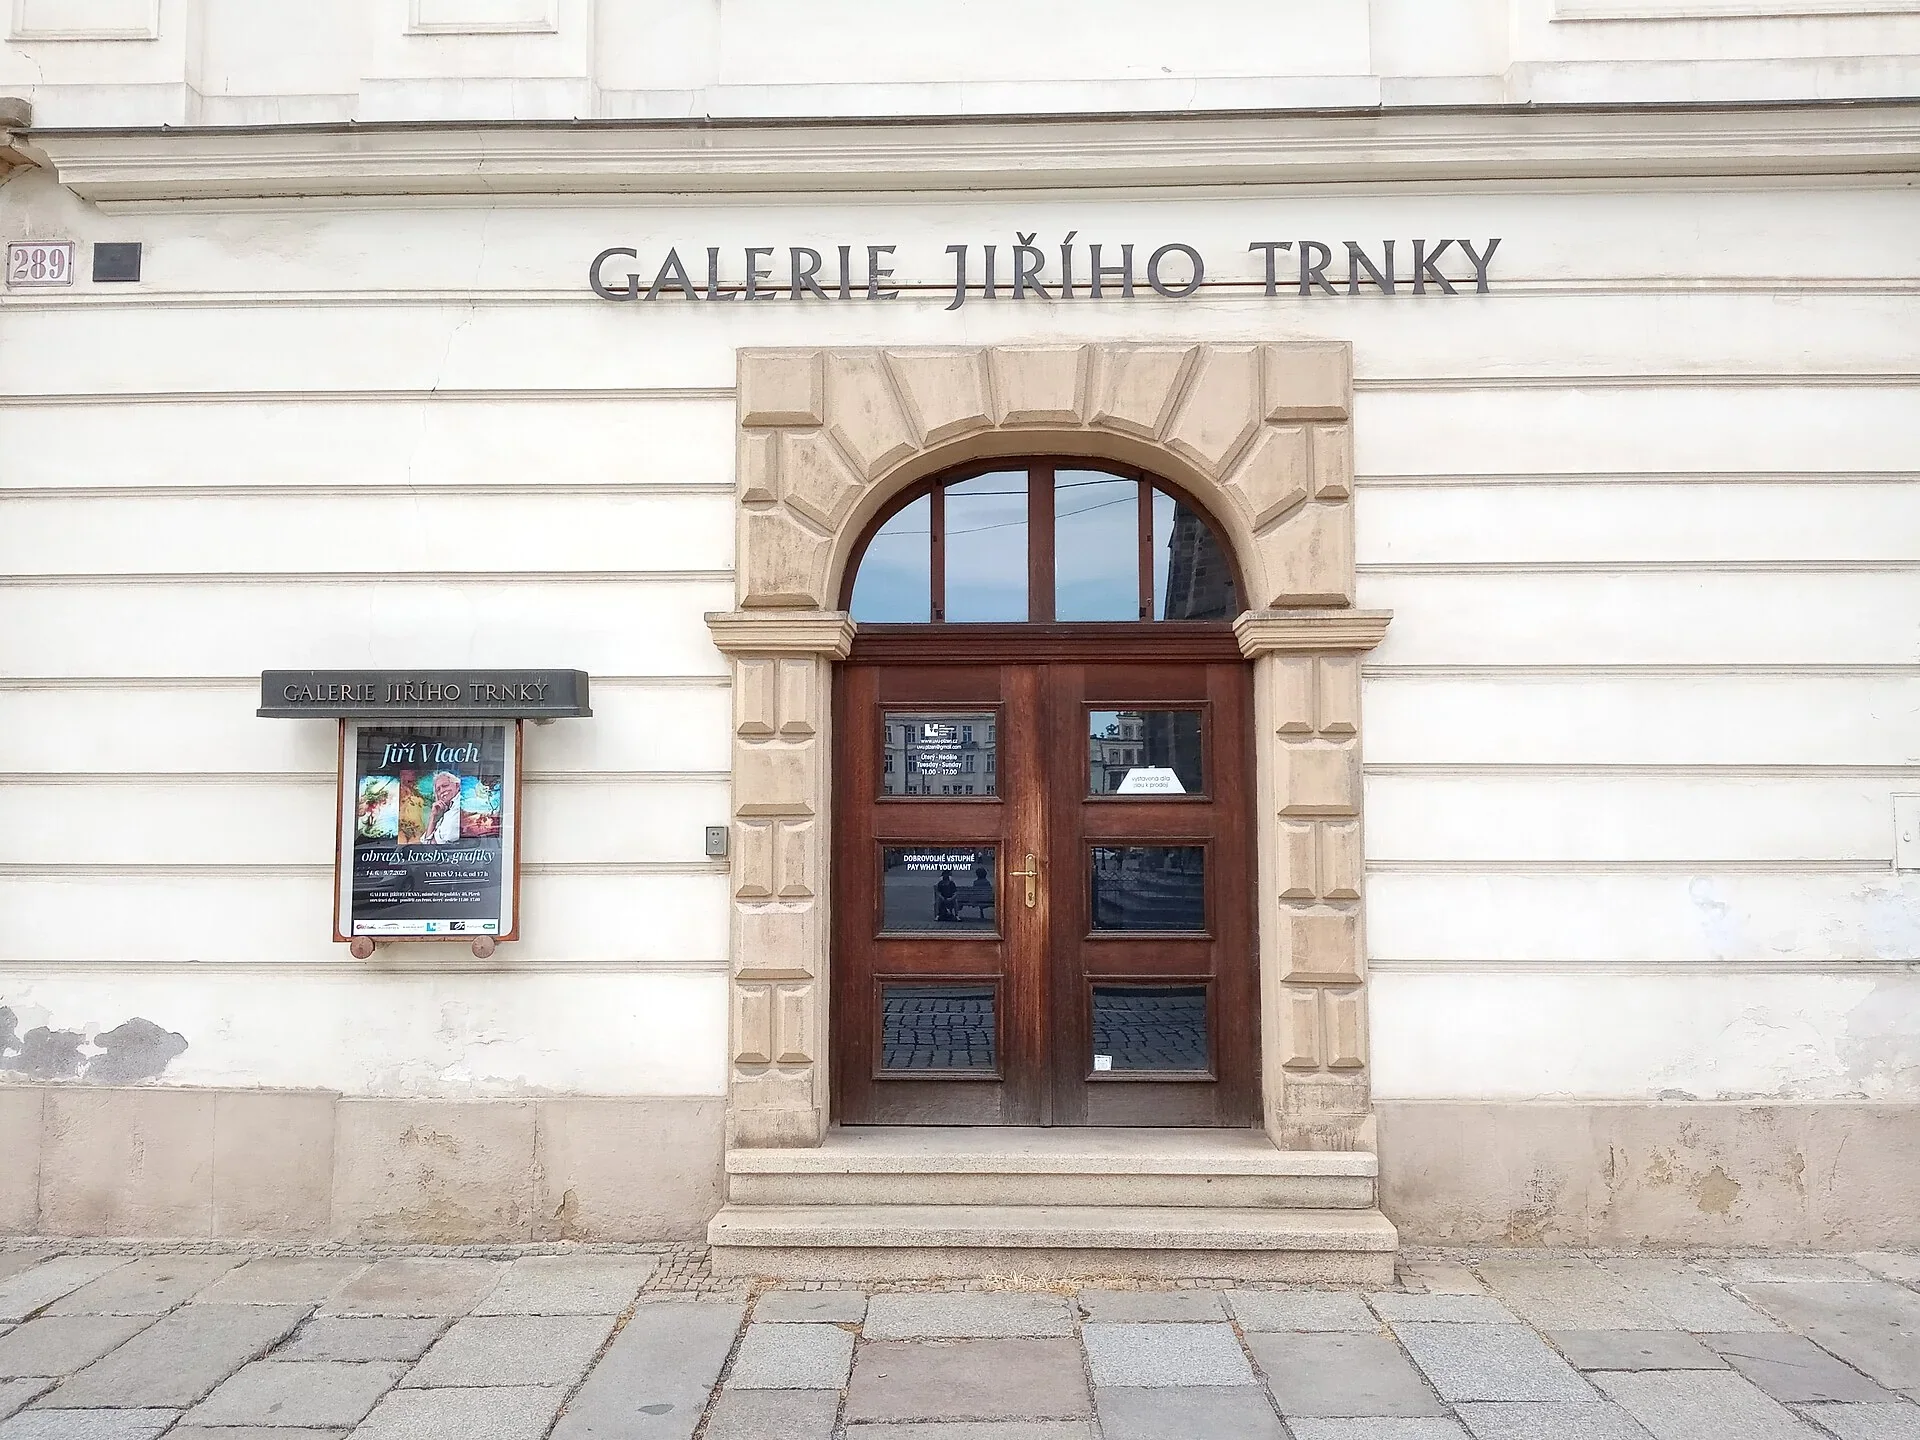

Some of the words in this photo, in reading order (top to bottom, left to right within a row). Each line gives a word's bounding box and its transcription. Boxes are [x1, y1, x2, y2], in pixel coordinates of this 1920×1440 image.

[13, 248, 65, 279] 289
[589, 244, 900, 301] GALERIE
[944, 231, 1205, 311] JIŘÍHO
[1248, 238, 1502, 297] TRNKY
[283, 683, 376, 702] GALERIE
[385, 680, 461, 703] JIŘÍHO
[469, 683, 549, 702] TRNKY
[378, 742, 416, 769] Jiří
[421, 742, 480, 763] Vlach
[361, 849, 405, 864] obrazy,
[407, 849, 450, 864] kresby,
[451, 849, 495, 865] grafiky
[903, 853, 946, 862] DOBROVOLNÉ
[907, 863, 919, 871] PAY
[919, 863, 938, 871] WHAT
[939, 863, 952, 871] YOU
[953, 863, 972, 871] WANT
